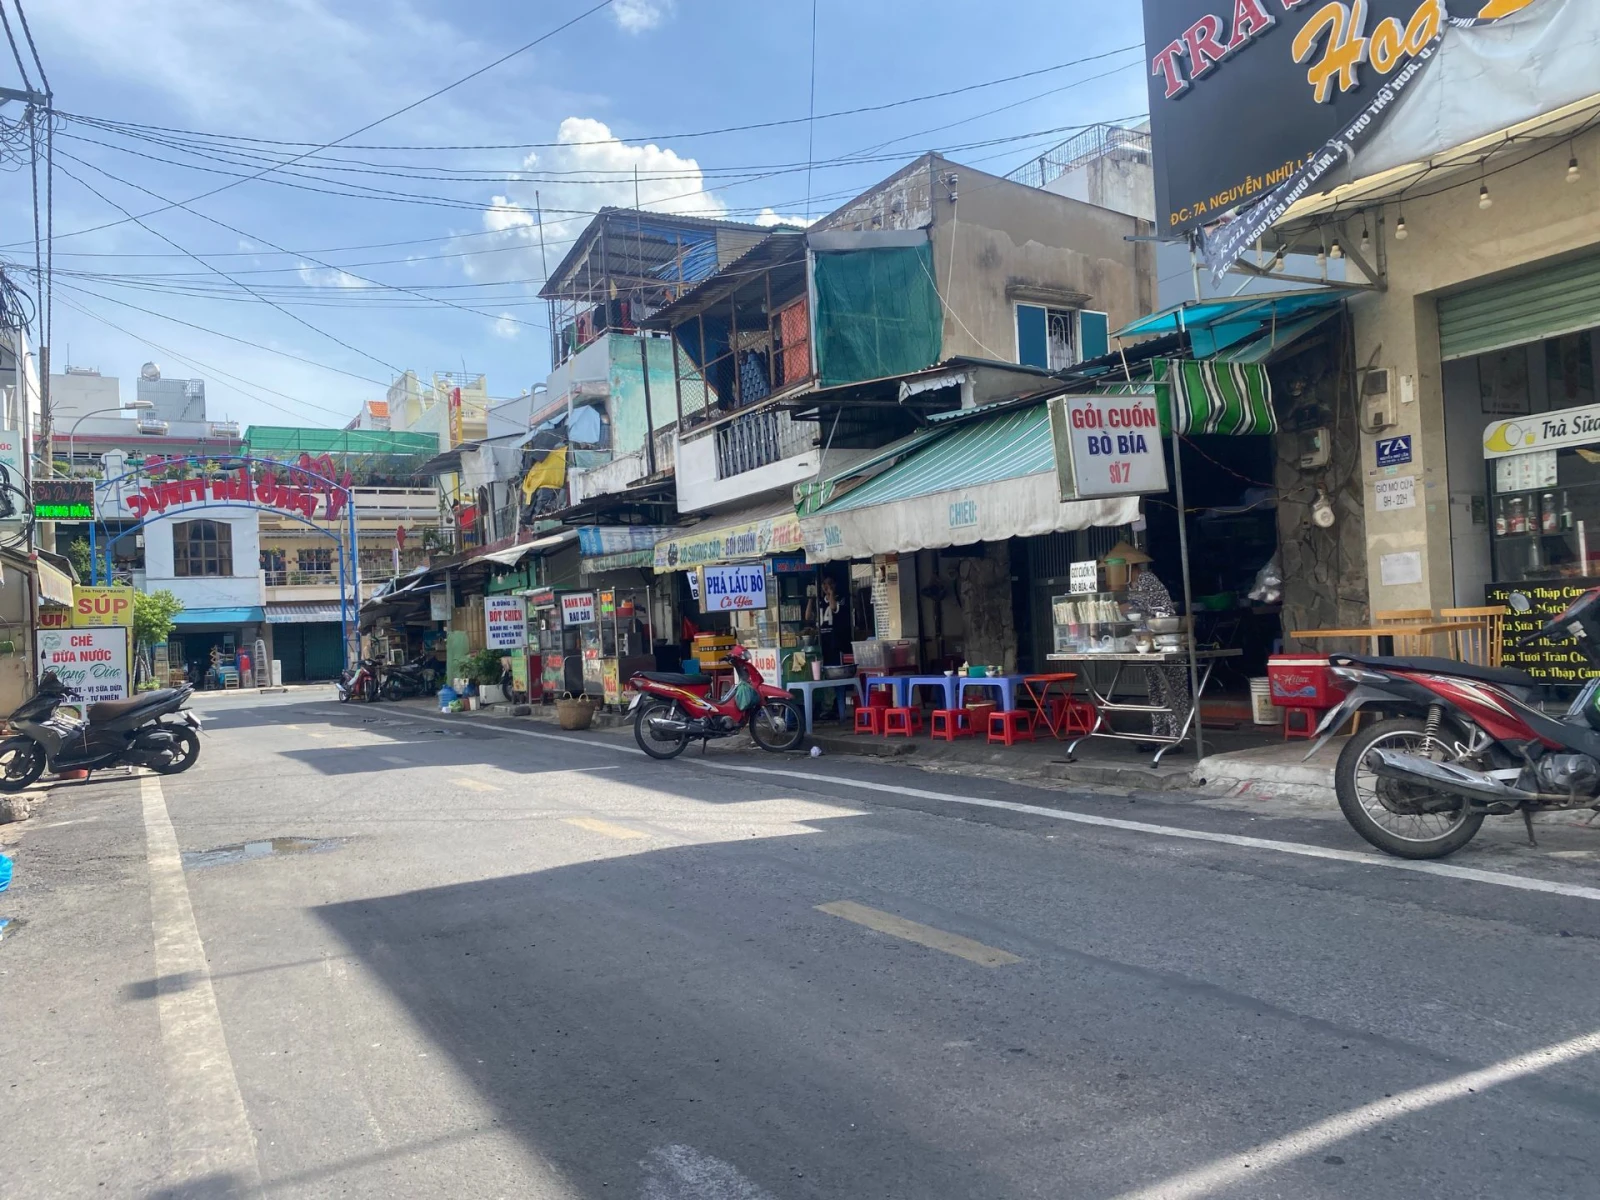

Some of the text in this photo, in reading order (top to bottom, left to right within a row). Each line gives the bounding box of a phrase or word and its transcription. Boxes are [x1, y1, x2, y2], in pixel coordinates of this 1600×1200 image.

[1170, 209, 1192, 226] ĐC:
[1193, 203, 1207, 217] 7A
[1210, 176, 1262, 210] NGUYỄN
[1072, 401, 1157, 429] GỎI CUỐN
[1542, 418, 1567, 439] Trà
[1087, 430, 1148, 455] BÒ BÍA
[1380, 438, 1409, 455] 7A
[1109, 461, 1131, 484] SỐ 7
[35, 505, 69, 517] PHONG
[707, 571, 728, 595] PHÁ
[729, 567, 749, 594] LẤU
[751, 570, 764, 593] BÒ
[78, 594, 129, 615] SÚP
[490, 608, 503, 625] BỘT
[71, 634, 93, 647] CHÈ
[53, 648, 112, 663] DỪA NƯỚC
[766, 654, 776, 671] BÒ
